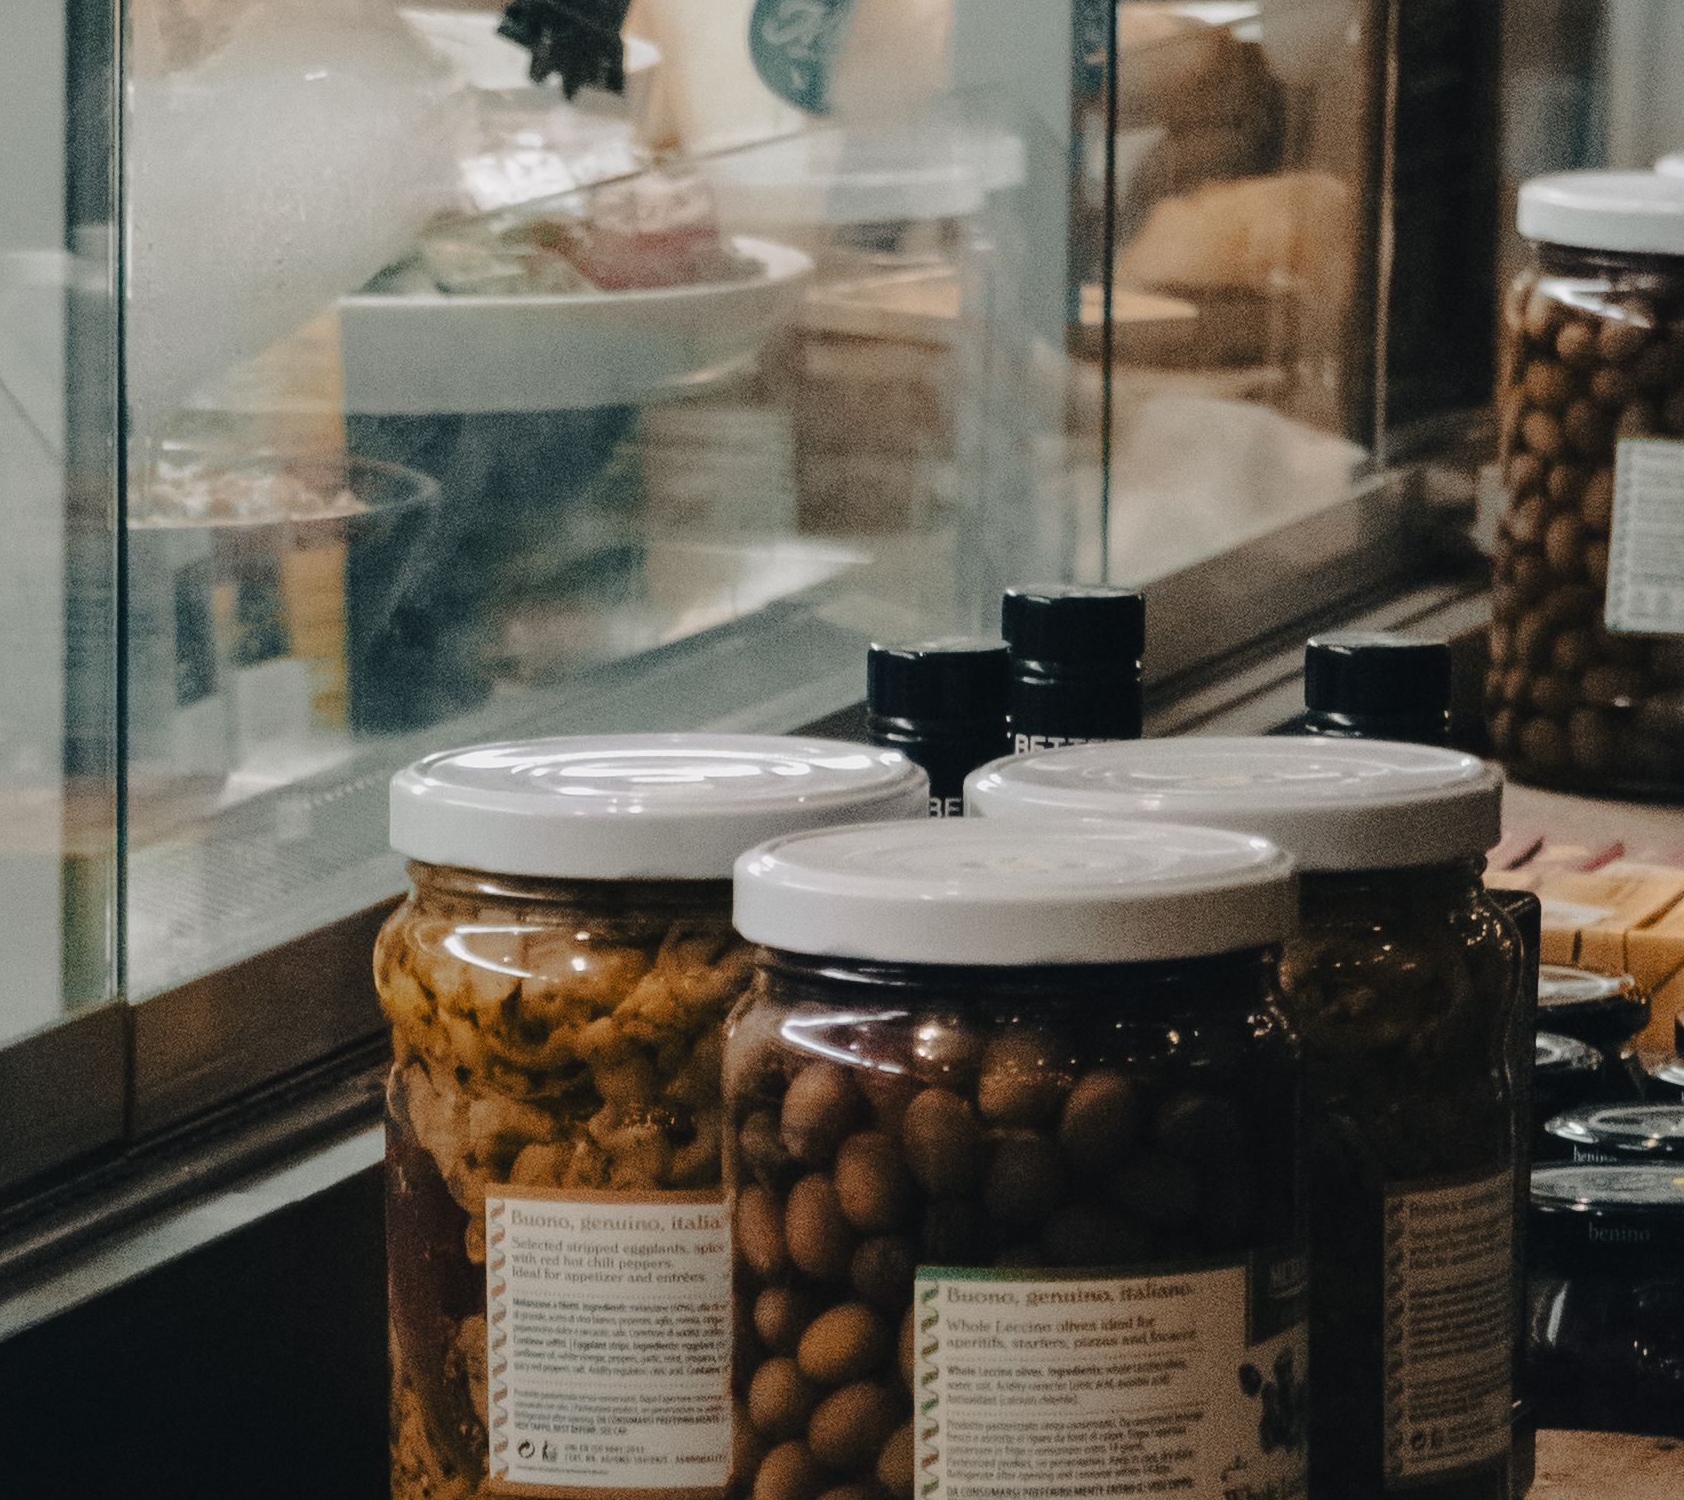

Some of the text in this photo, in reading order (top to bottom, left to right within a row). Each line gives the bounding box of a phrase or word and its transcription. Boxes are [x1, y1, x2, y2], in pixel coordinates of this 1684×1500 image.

[512, 1209, 575, 1231] Buono,
[580, 1214, 665, 1234] genuino,
[1588, 1220, 1651, 1242] benino
[512, 1237, 564, 1252] Selected
[567, 1242, 619, 1255] stripped
[512, 1253, 538, 1265] with
[541, 1255, 560, 1267] red
[563, 1255, 584, 1267] hot
[512, 1265, 541, 1279] Ideal
[544, 1268, 561, 1280] for
[565, 1271, 623, 1284] appetizer
[629, 1272, 652, 1283] and
[947, 1287, 1020, 1306] Buono,
[1025, 1288, 1114, 1307] genuino,
[946, 1318, 991, 1332] Whole
[995, 1319, 1052, 1333] Leccino
[1056, 1319, 1097, 1333] olives
[1136, 1314, 1156, 1329] for
